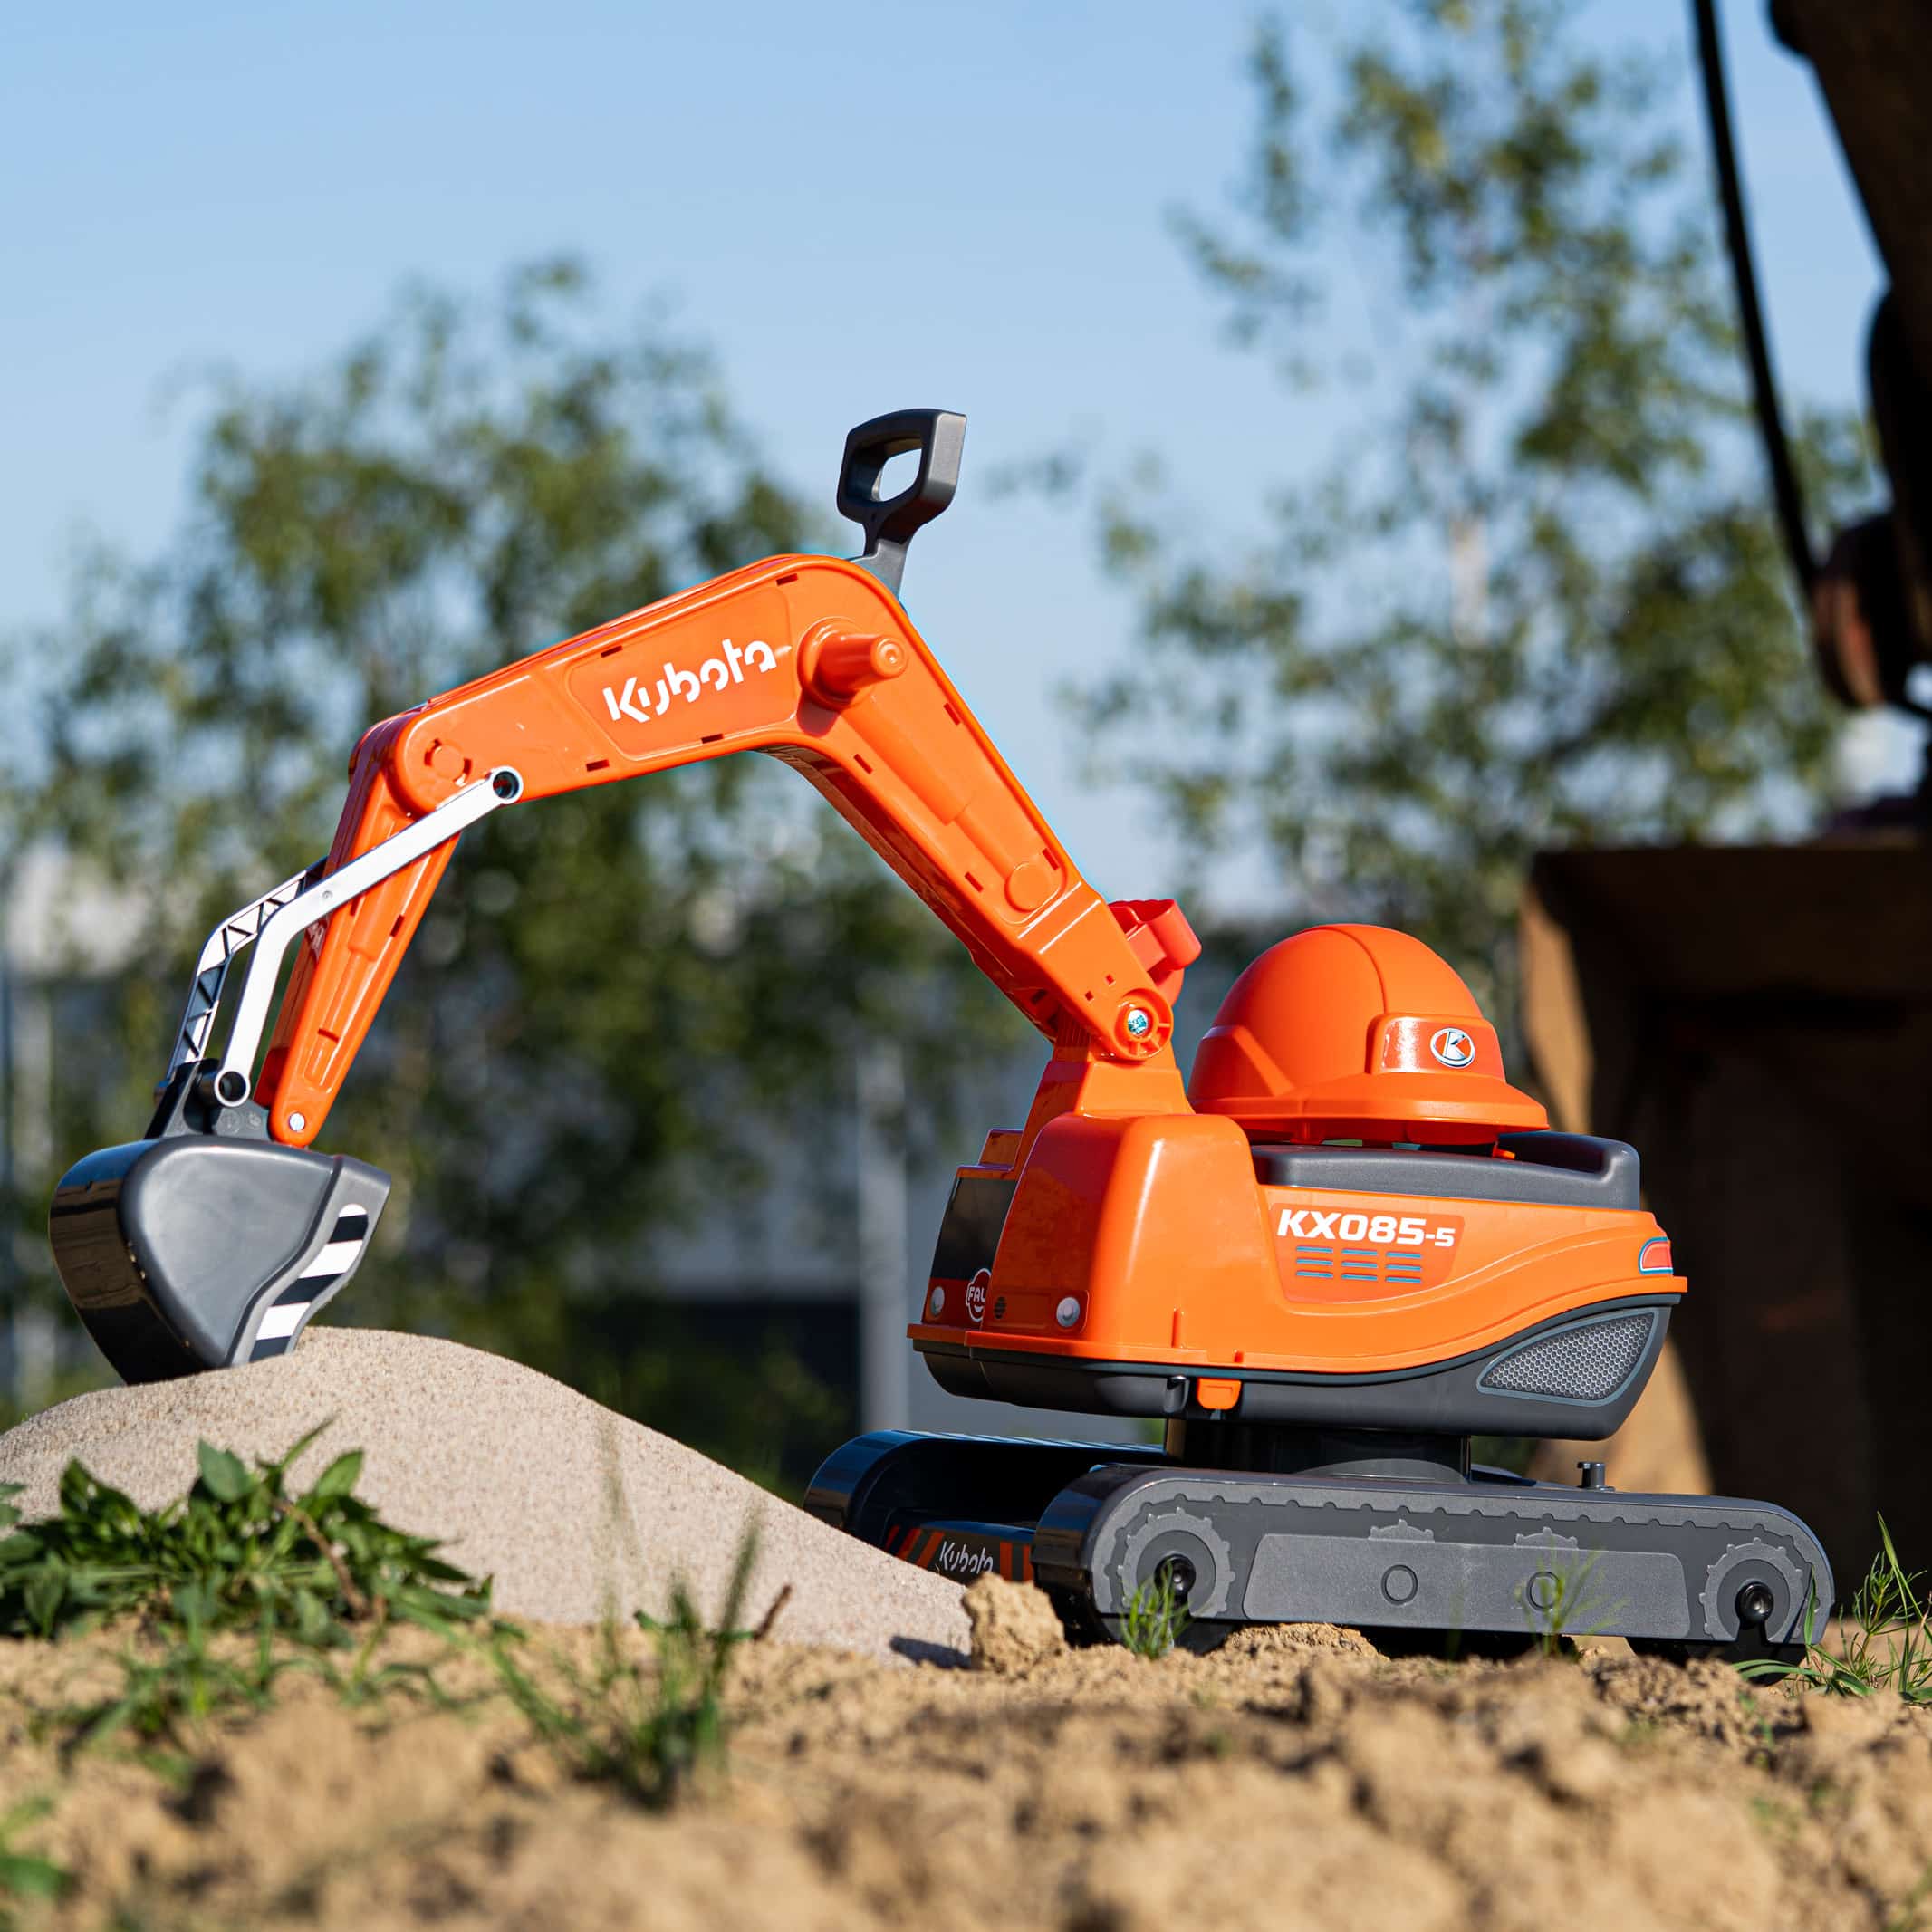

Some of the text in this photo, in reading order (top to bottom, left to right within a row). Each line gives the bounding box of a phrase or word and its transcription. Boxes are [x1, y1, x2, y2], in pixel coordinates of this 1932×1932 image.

[602, 638, 778, 724] Kubota
[1439, 1029, 1469, 1062] K
[1276, 1208, 1456, 1247] KX085-5
[967, 1286, 987, 1303] FAL
[939, 1541, 994, 1575] Kubota
